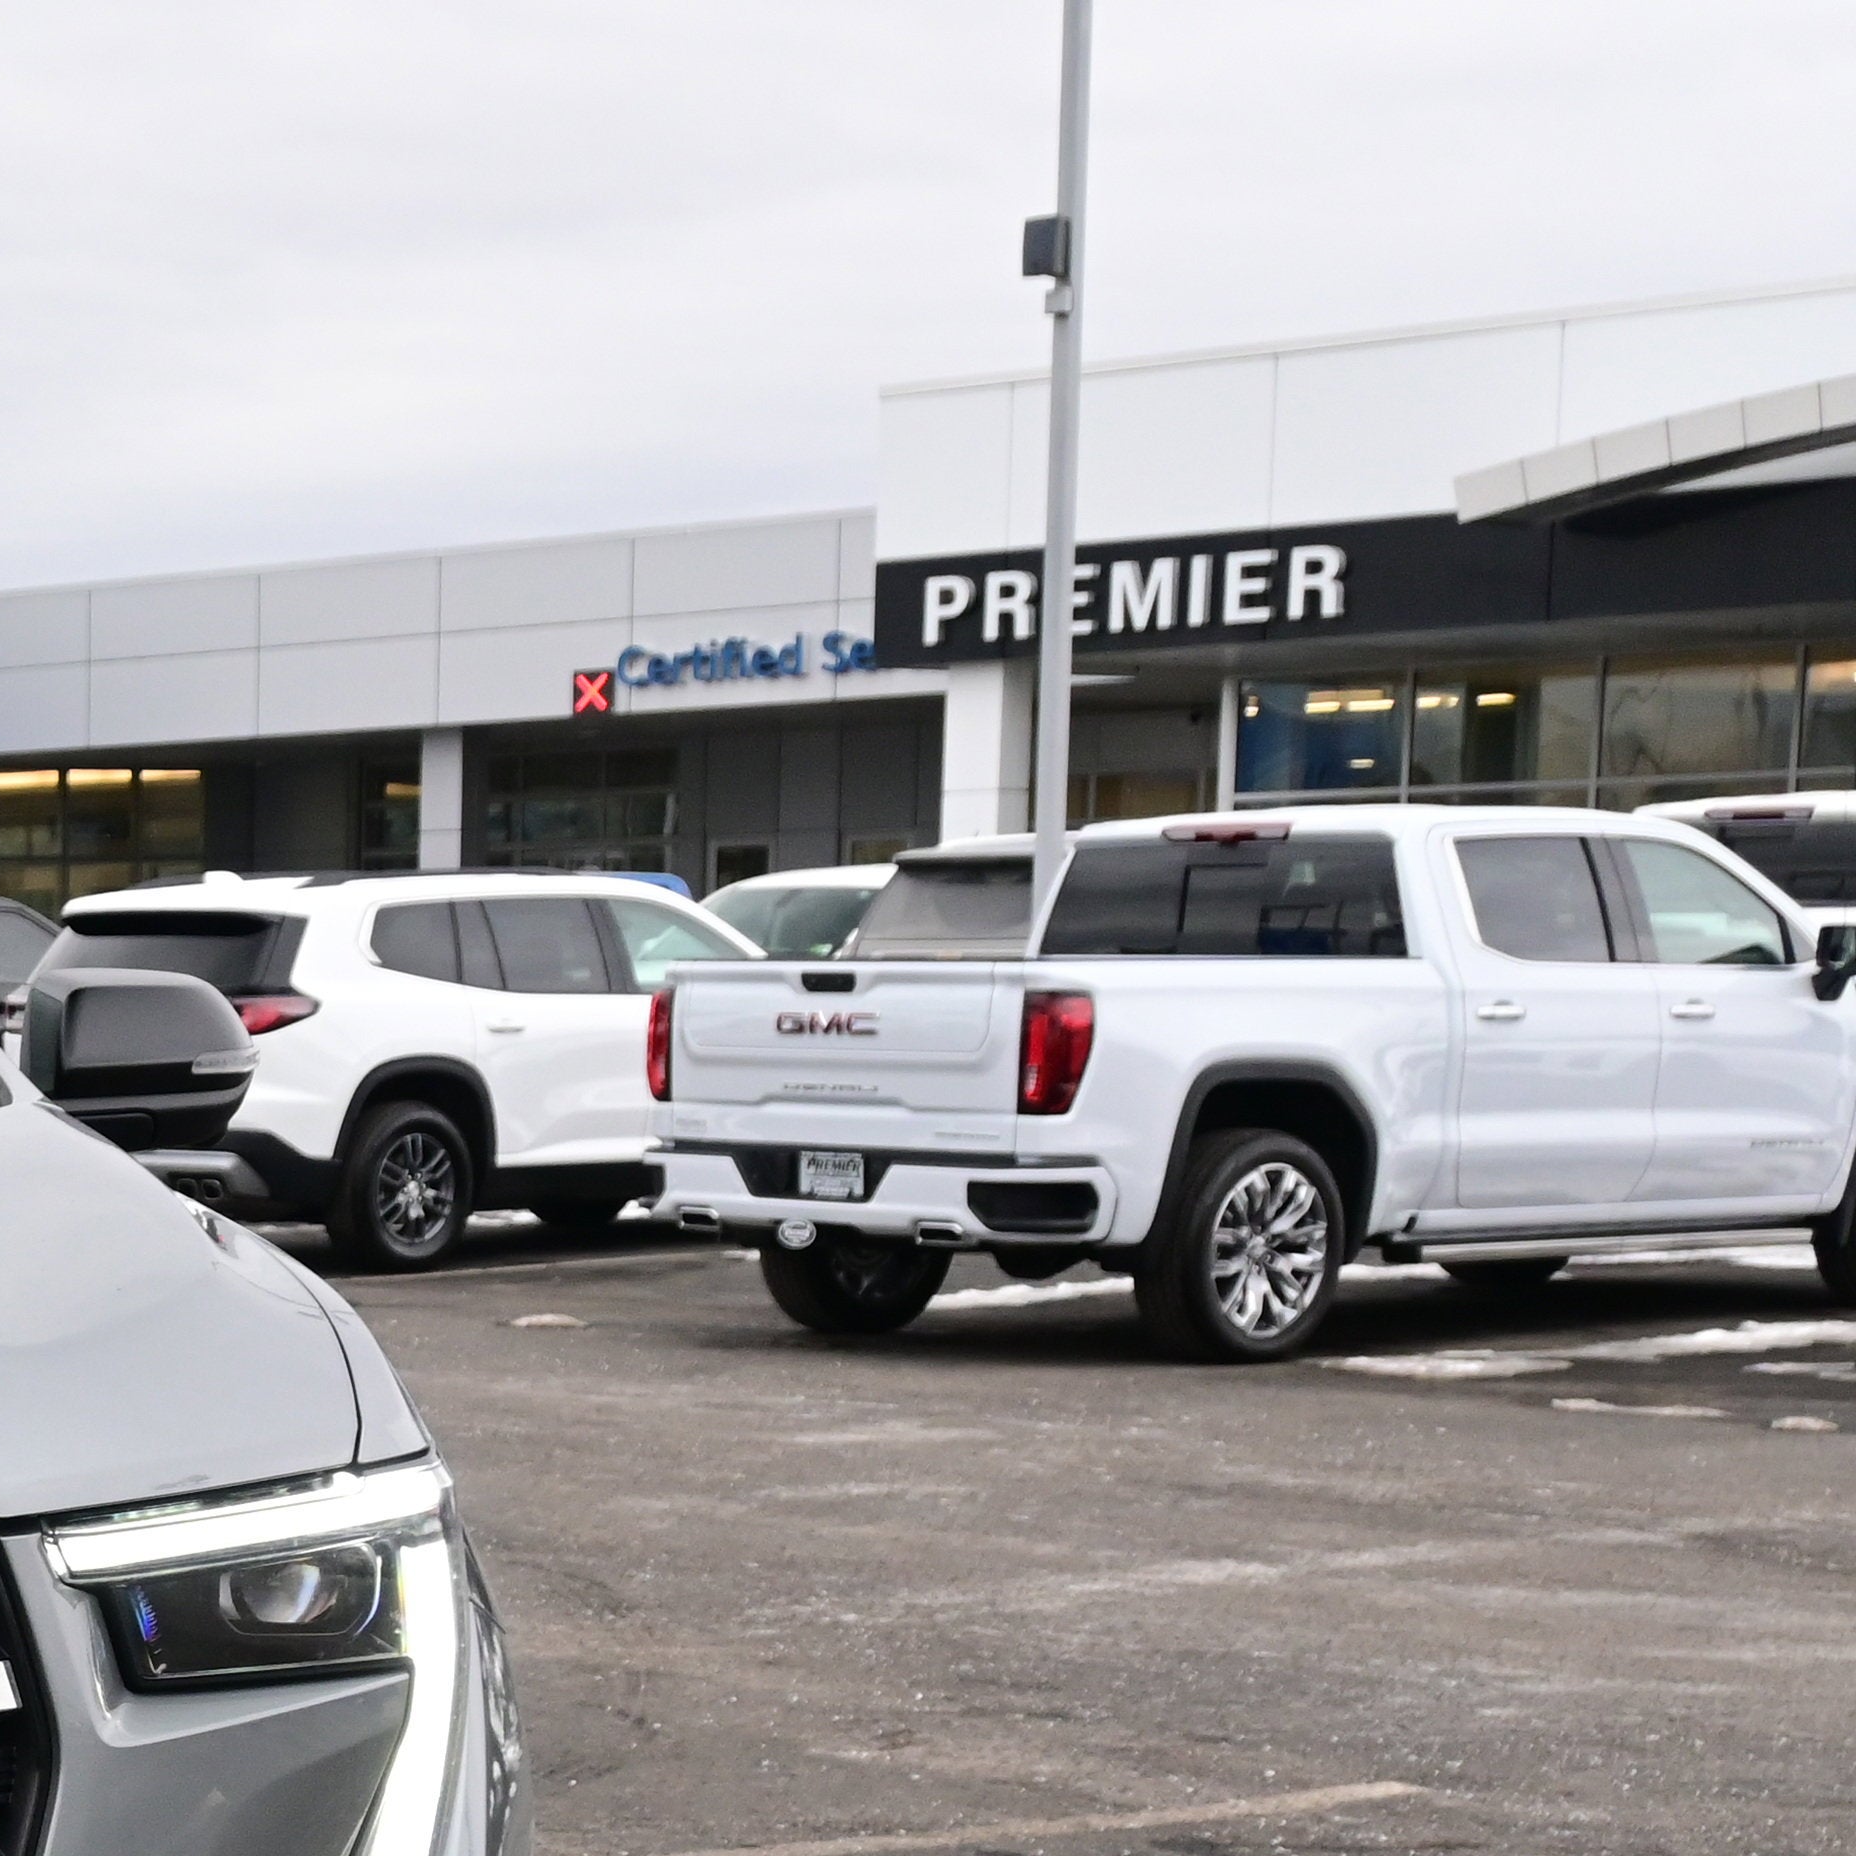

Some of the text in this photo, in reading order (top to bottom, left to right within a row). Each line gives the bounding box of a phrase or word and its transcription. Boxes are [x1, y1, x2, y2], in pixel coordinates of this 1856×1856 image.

[922, 545, 1346, 648] PREMIER
[617, 631, 805, 687] Certified
[777, 1011, 881, 1036] GMC
[806, 1155, 862, 1172] PREMIER
